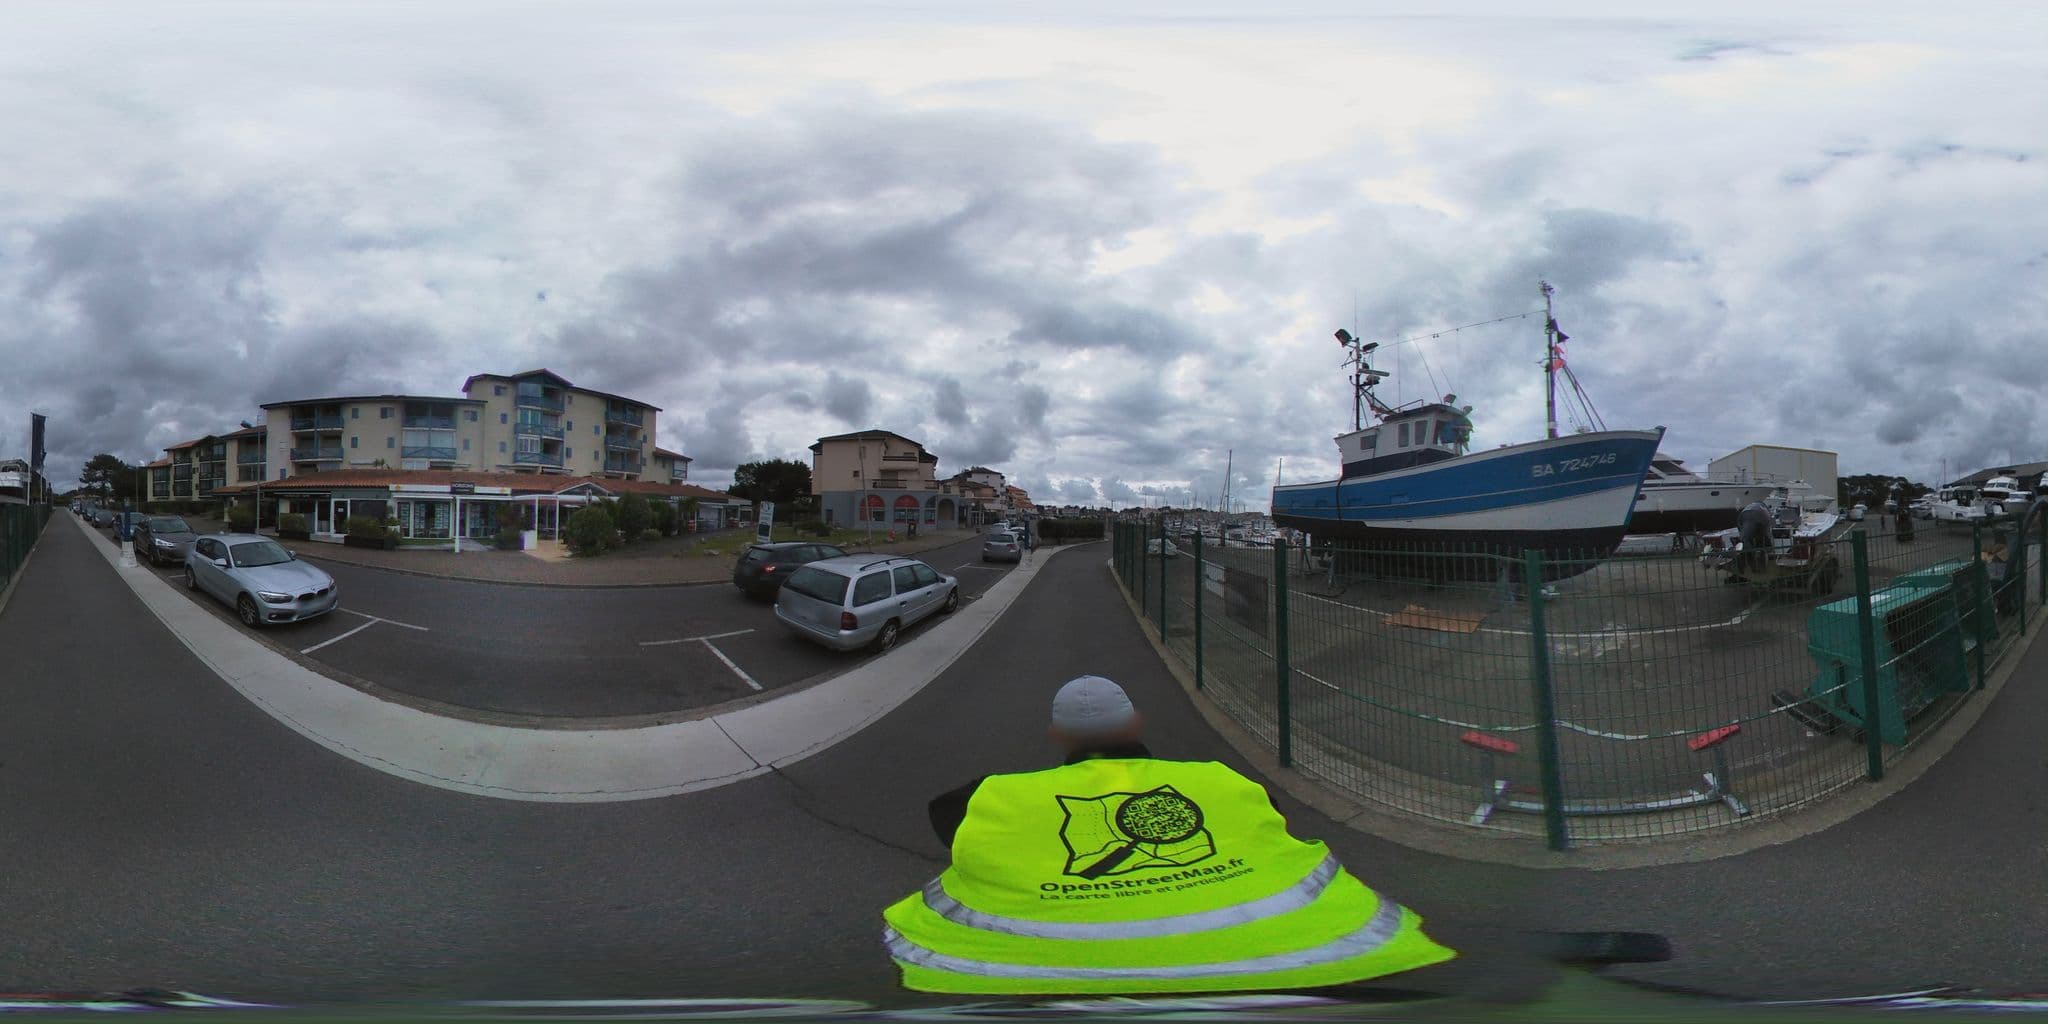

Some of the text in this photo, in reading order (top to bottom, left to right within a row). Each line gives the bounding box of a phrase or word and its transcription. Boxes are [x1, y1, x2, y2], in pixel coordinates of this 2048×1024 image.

[1532, 463, 1554, 477] BA
[1040, 858, 1245, 893] OpenStreetMap.fr
[1116, 888, 1152, 897] libre
[1177, 867, 1254, 891] participative
